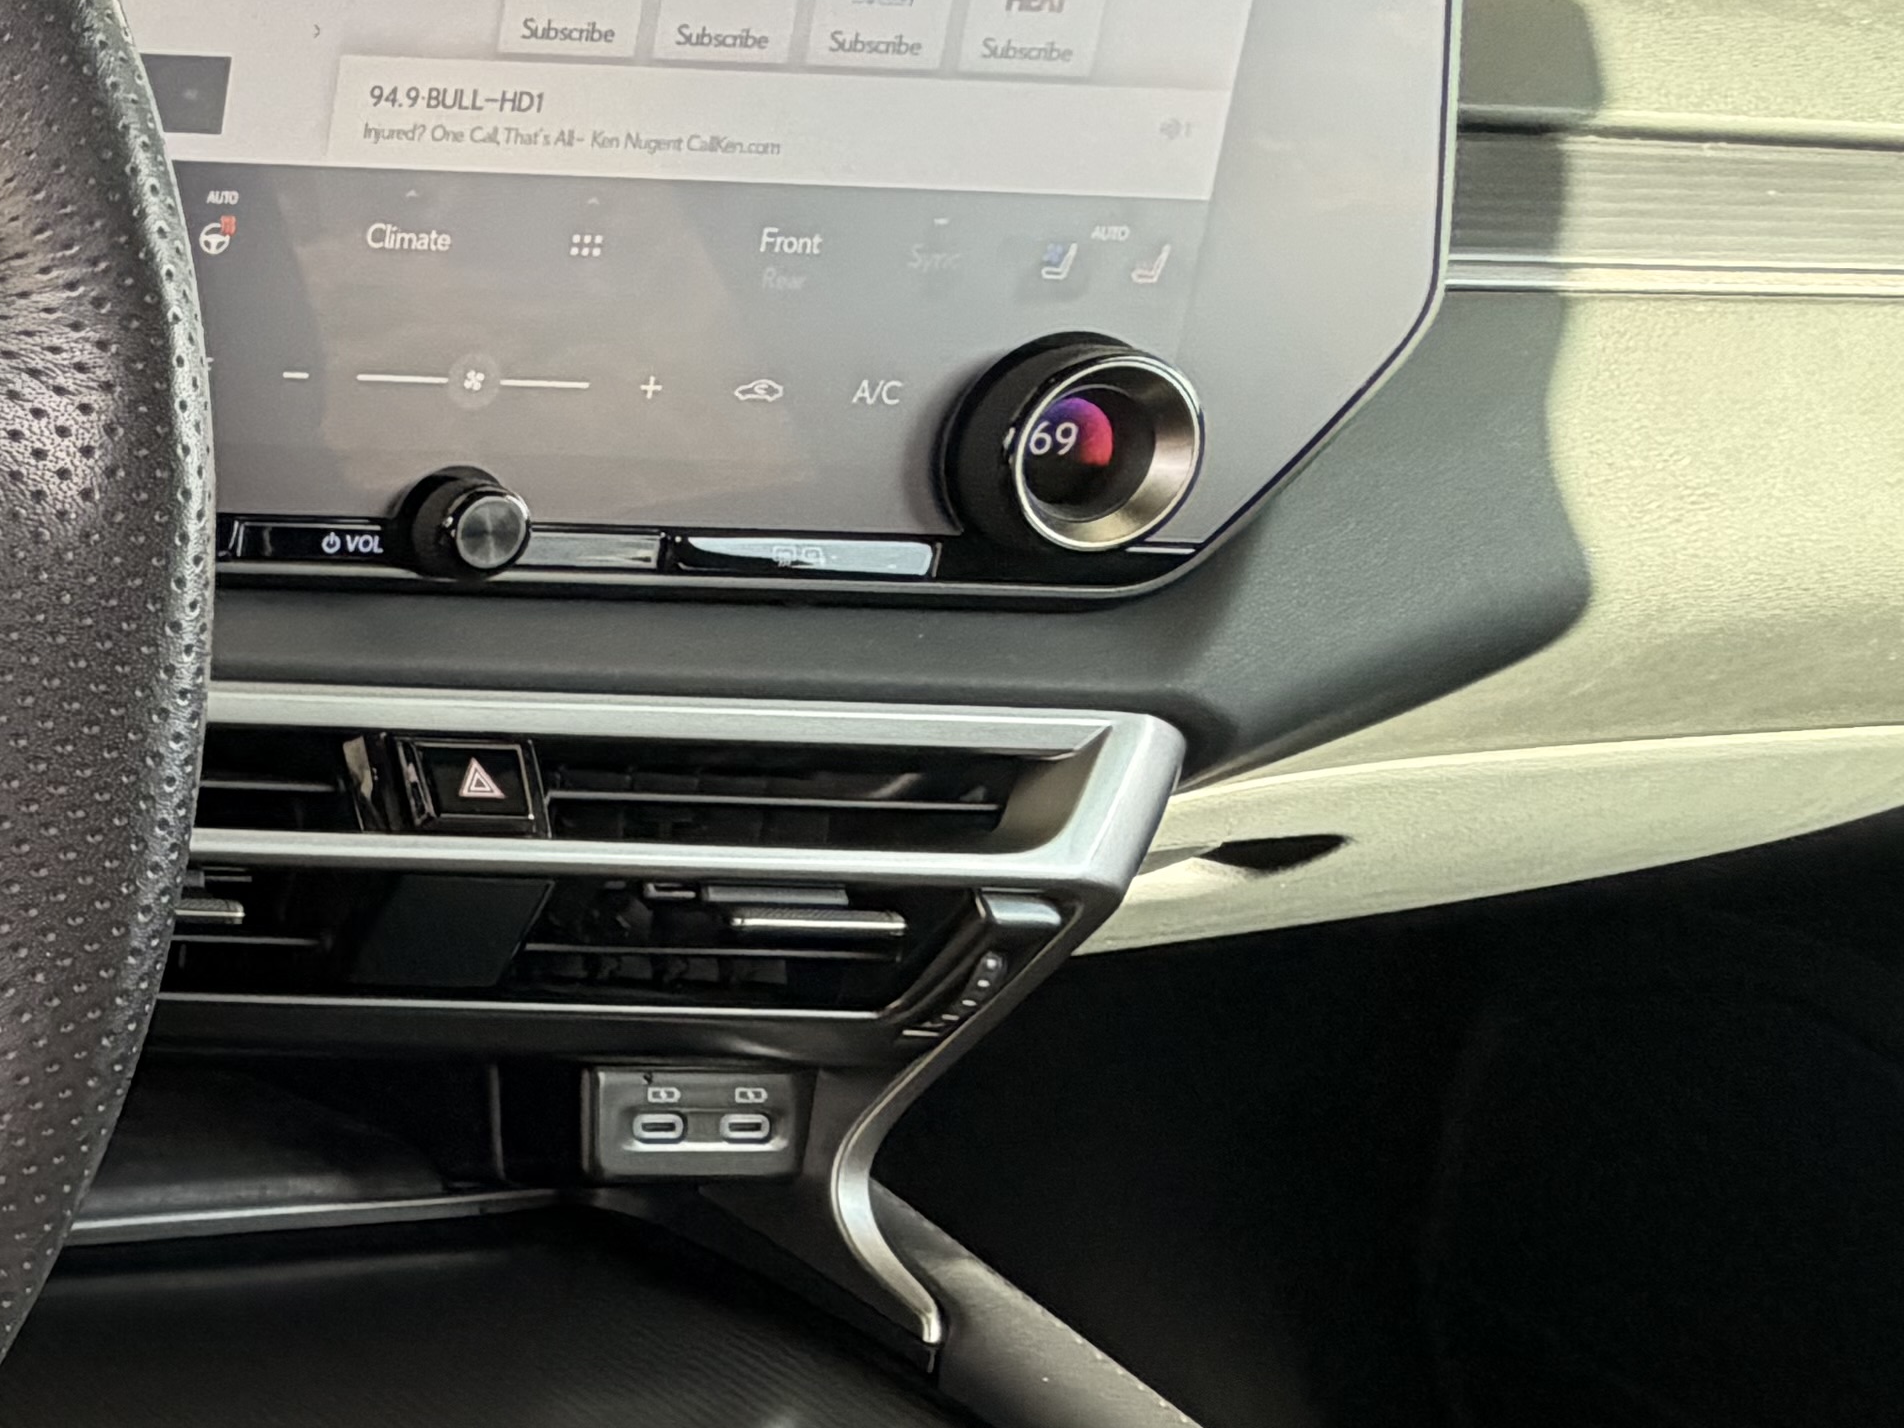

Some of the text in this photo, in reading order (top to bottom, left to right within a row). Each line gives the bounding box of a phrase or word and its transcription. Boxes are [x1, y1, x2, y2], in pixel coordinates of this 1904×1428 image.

[520, 17, 615, 44] Subscribe
[675, 23, 769, 49] Subscribe
[829, 30, 922, 56] Subscribe
[981, 37, 1073, 63] Subscribe
[431, 125, 465, 143] One
[591, 130, 620, 149] Ken
[624, 132, 683, 155] Nugent
[206, 190, 240, 206] AUTO
[366, 221, 452, 252] Climate
[759, 226, 823, 255] Front
[1090, 224, 1131, 243] AUTO
[851, 378, 905, 407] A/C
[1028, 419, 1080, 457] 69
[344, 534, 385, 555] VOL
